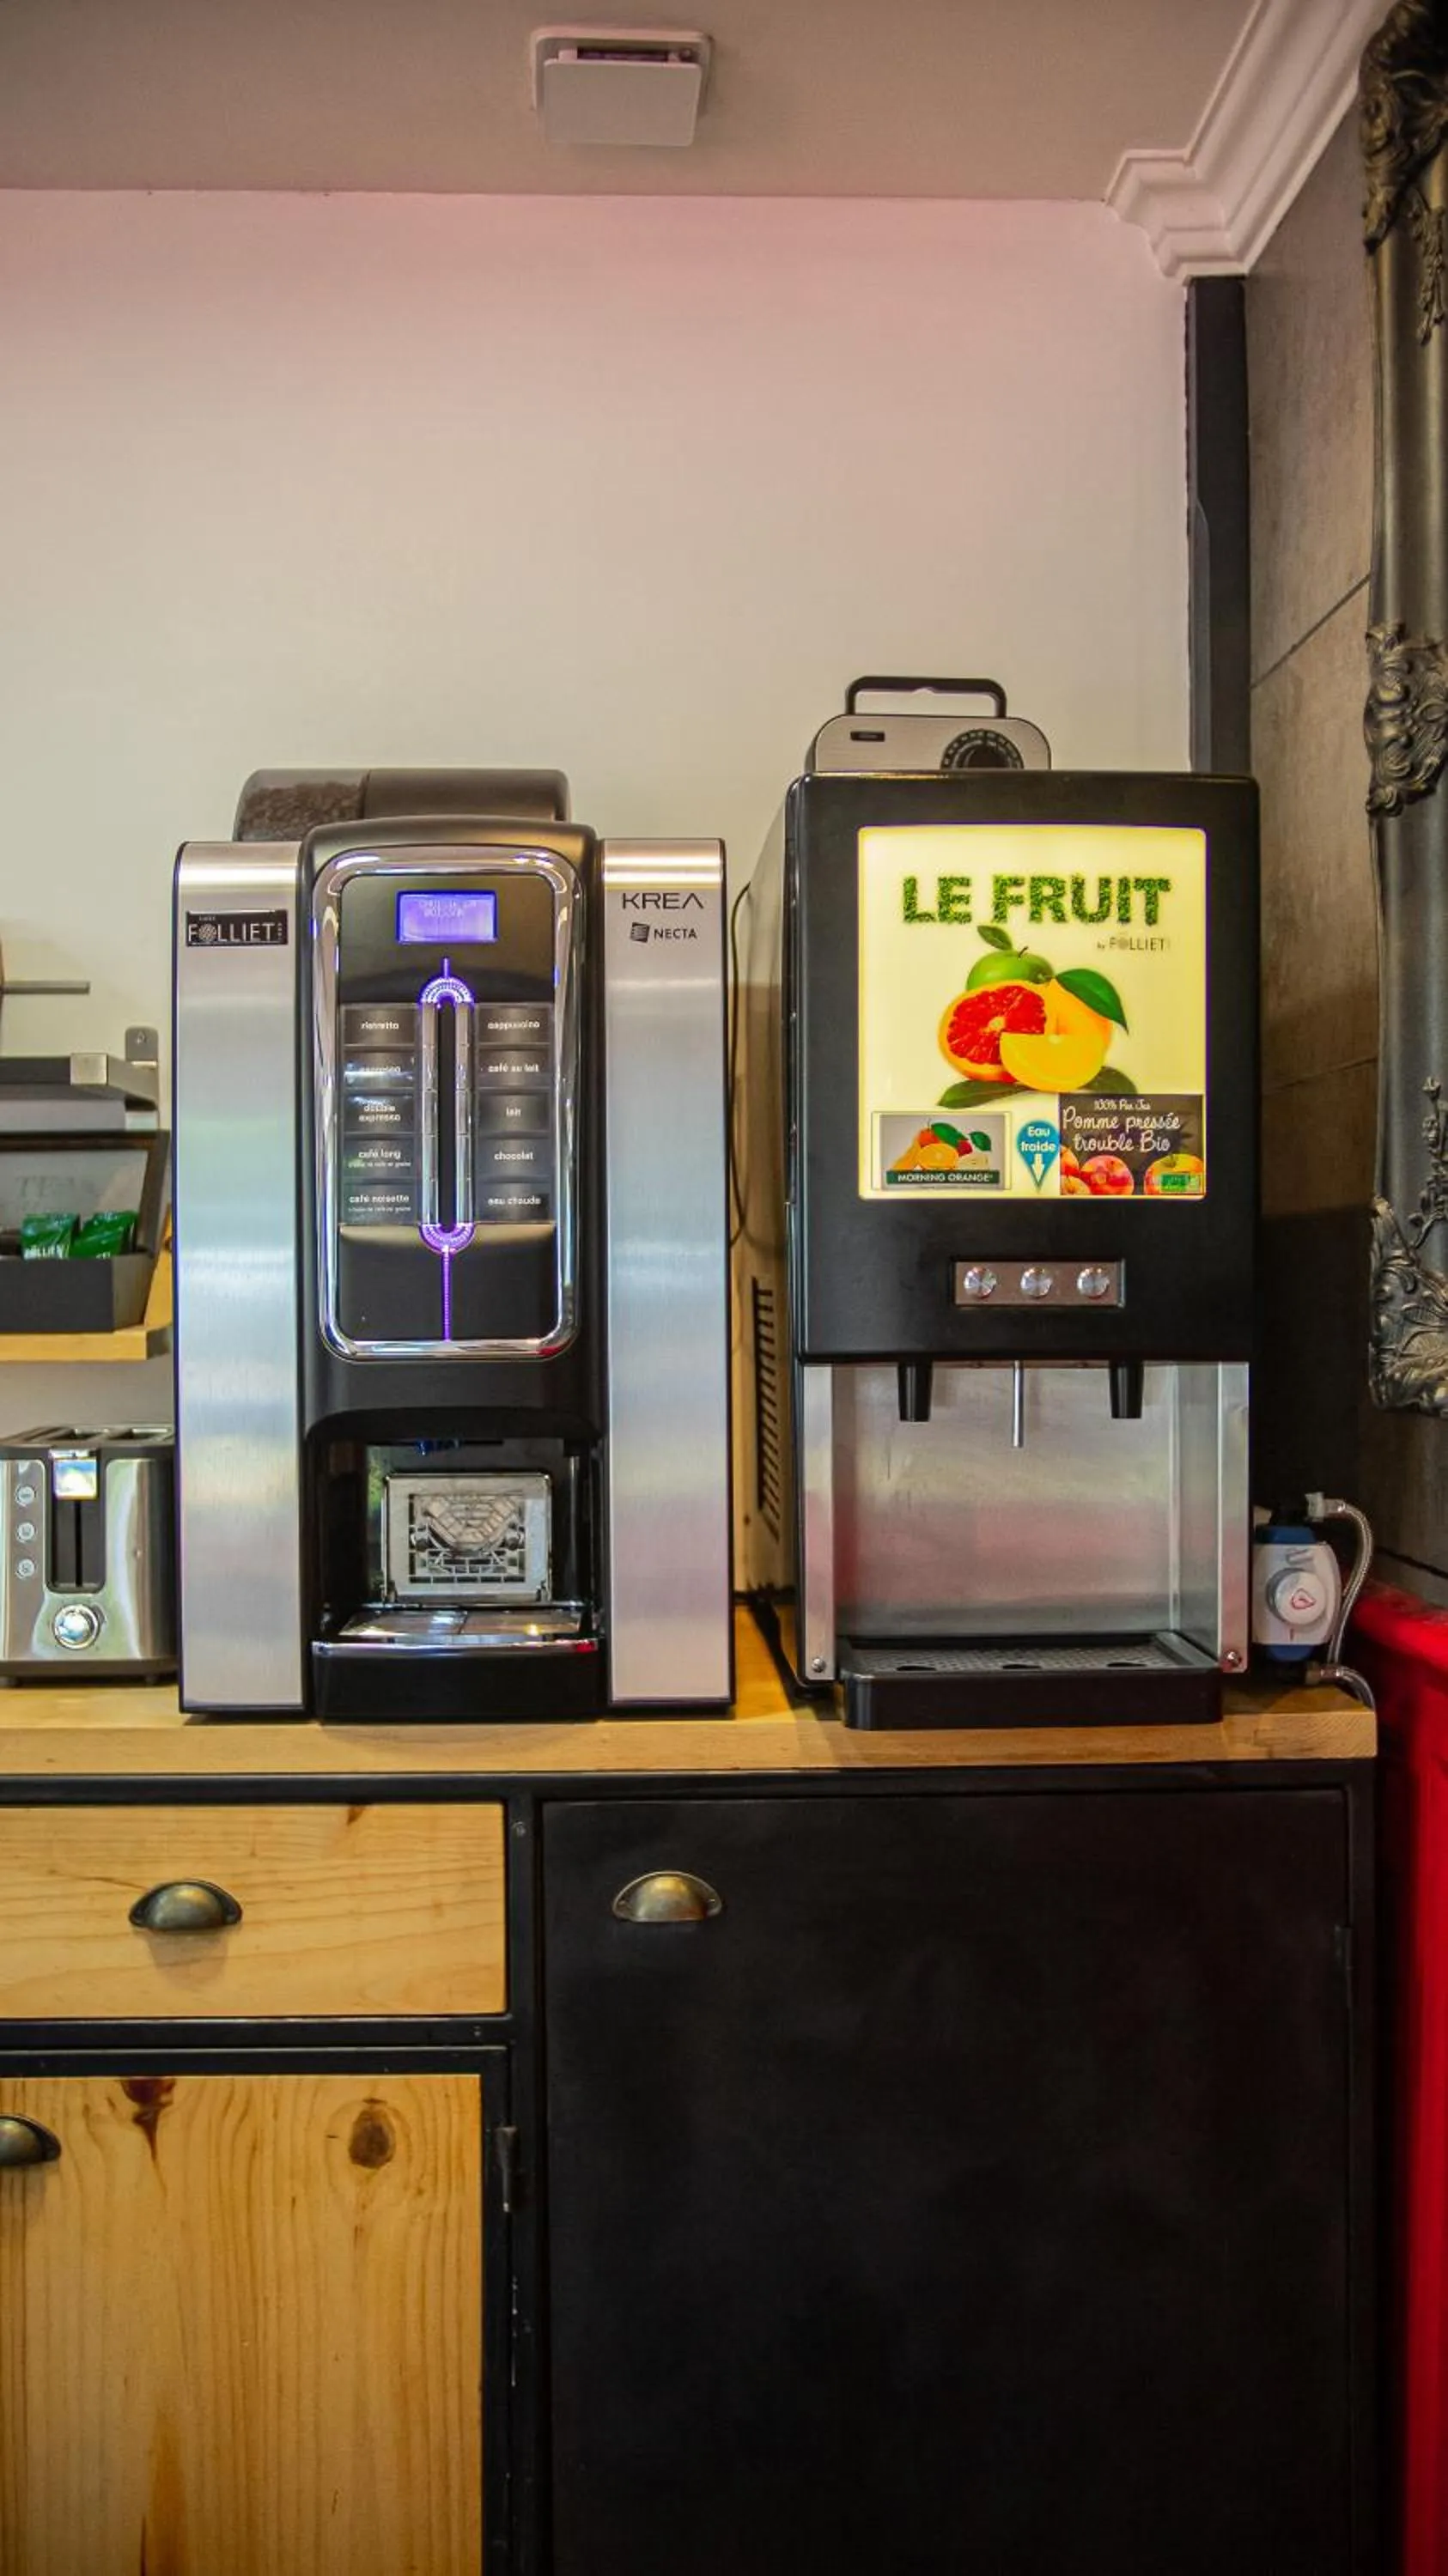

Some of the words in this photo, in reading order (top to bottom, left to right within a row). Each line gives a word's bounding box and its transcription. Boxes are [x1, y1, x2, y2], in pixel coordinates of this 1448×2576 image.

[622, 892, 704, 909] KREA
[903, 875, 972, 924] LE
[991, 873, 1171, 926] FRUIT
[188, 922, 276, 943] FOLLIET
[654, 928, 697, 940] NECTA
[1109, 936, 1165, 951] FOLLIET
[361, 1021, 399, 1030] ristretto
[487, 1019, 540, 1030] cappuccino
[488, 1063, 508, 1072] café
[524, 1064, 539, 1072] lait
[1094, 1099, 1116, 1110] 100%
[506, 1107, 521, 1116] lait
[1062, 1106, 1120, 1130] Pomme
[1125, 1112, 1181, 1133] pressée
[1027, 1126, 1049, 1137] Eau
[1020, 1141, 1056, 1152] froide
[1073, 1133, 1135, 1151] trouble
[1140, 1130, 1171, 1152] Bio
[358, 1148, 379, 1158] café
[380, 1148, 401, 1160] long
[494, 1151, 534, 1160] chocolat
[897, 1173, 946, 1182] MORNING
[349, 1194, 369, 1203] café
[372, 1194, 410, 1203] noisette
[508, 1195, 542, 1205] chaude
